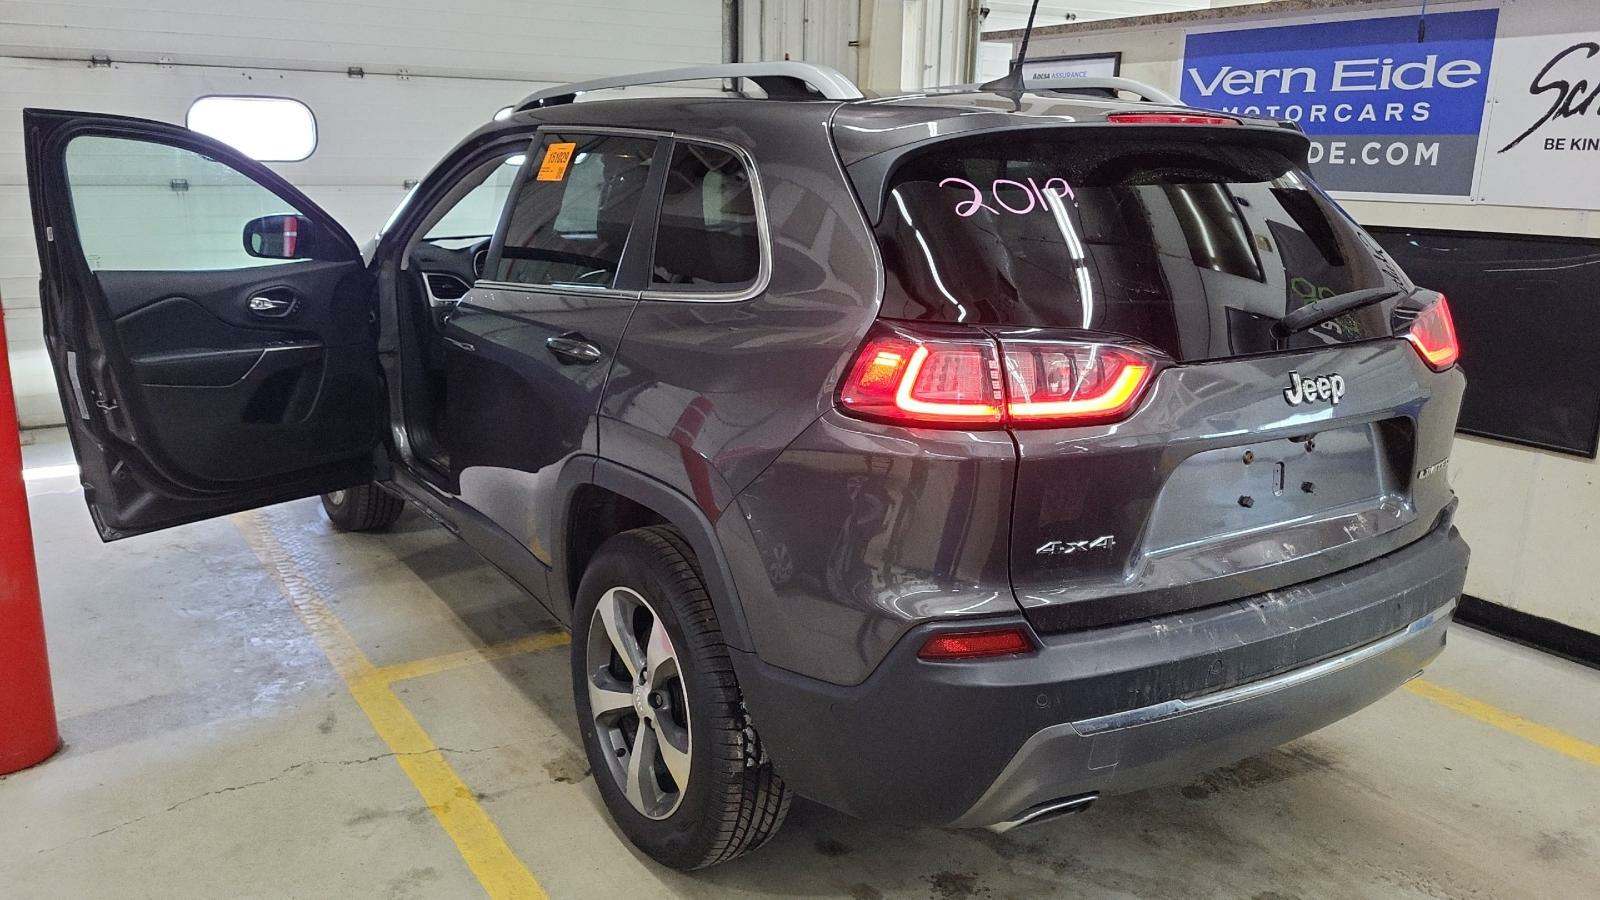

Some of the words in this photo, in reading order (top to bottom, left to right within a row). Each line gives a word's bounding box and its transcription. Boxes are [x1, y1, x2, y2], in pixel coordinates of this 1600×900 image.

[1188, 66, 1316, 96] Vern
[1330, 55, 1481, 92] Eide
[1308, 142, 1439, 166] DE.COM
[1544, 138, 1565, 151] BE
[1570, 138, 1600, 151] KIN
[939, 177, 1075, 217] 2019
[1284, 370, 1346, 406] Jeep
